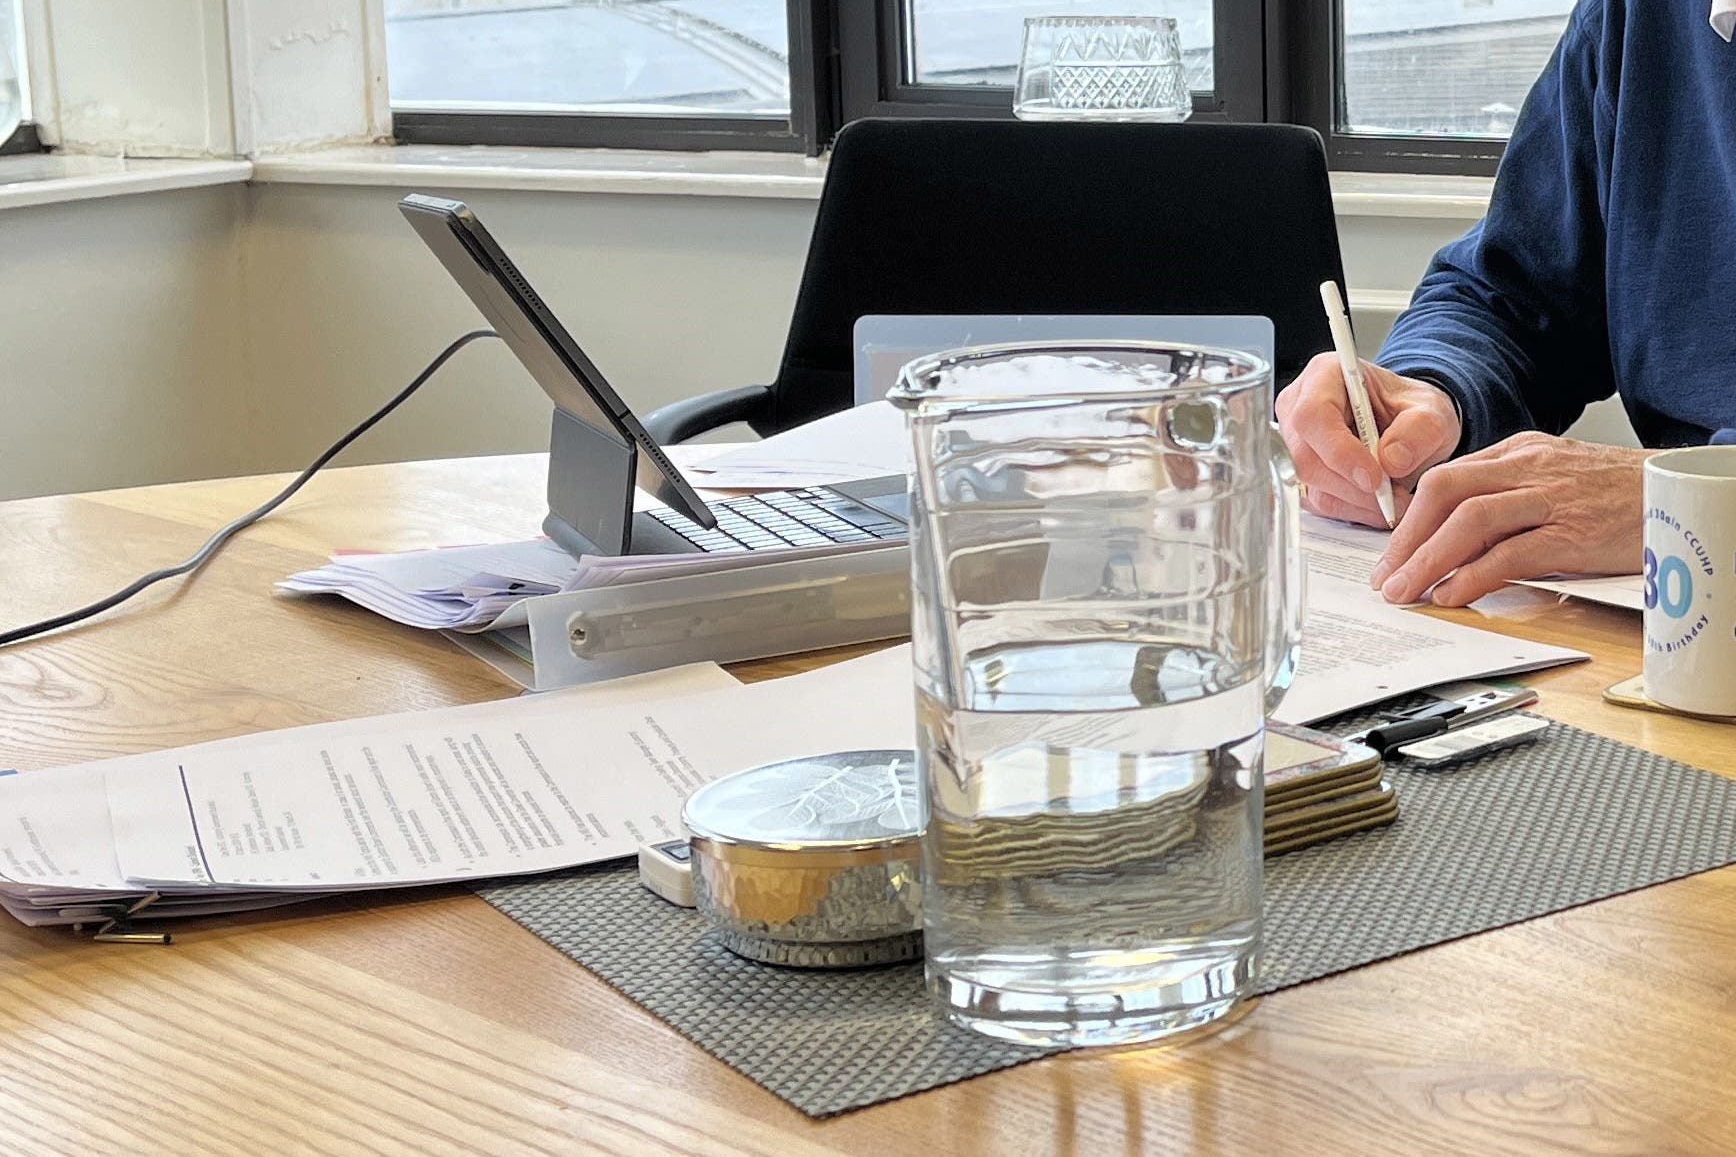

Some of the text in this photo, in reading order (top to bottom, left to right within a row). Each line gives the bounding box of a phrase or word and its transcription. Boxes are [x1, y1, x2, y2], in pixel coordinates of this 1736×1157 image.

[1684, 530, 1714, 577] CCUHP
[1644, 546, 1693, 619] 30
[1666, 614, 1709, 652] Birthday
